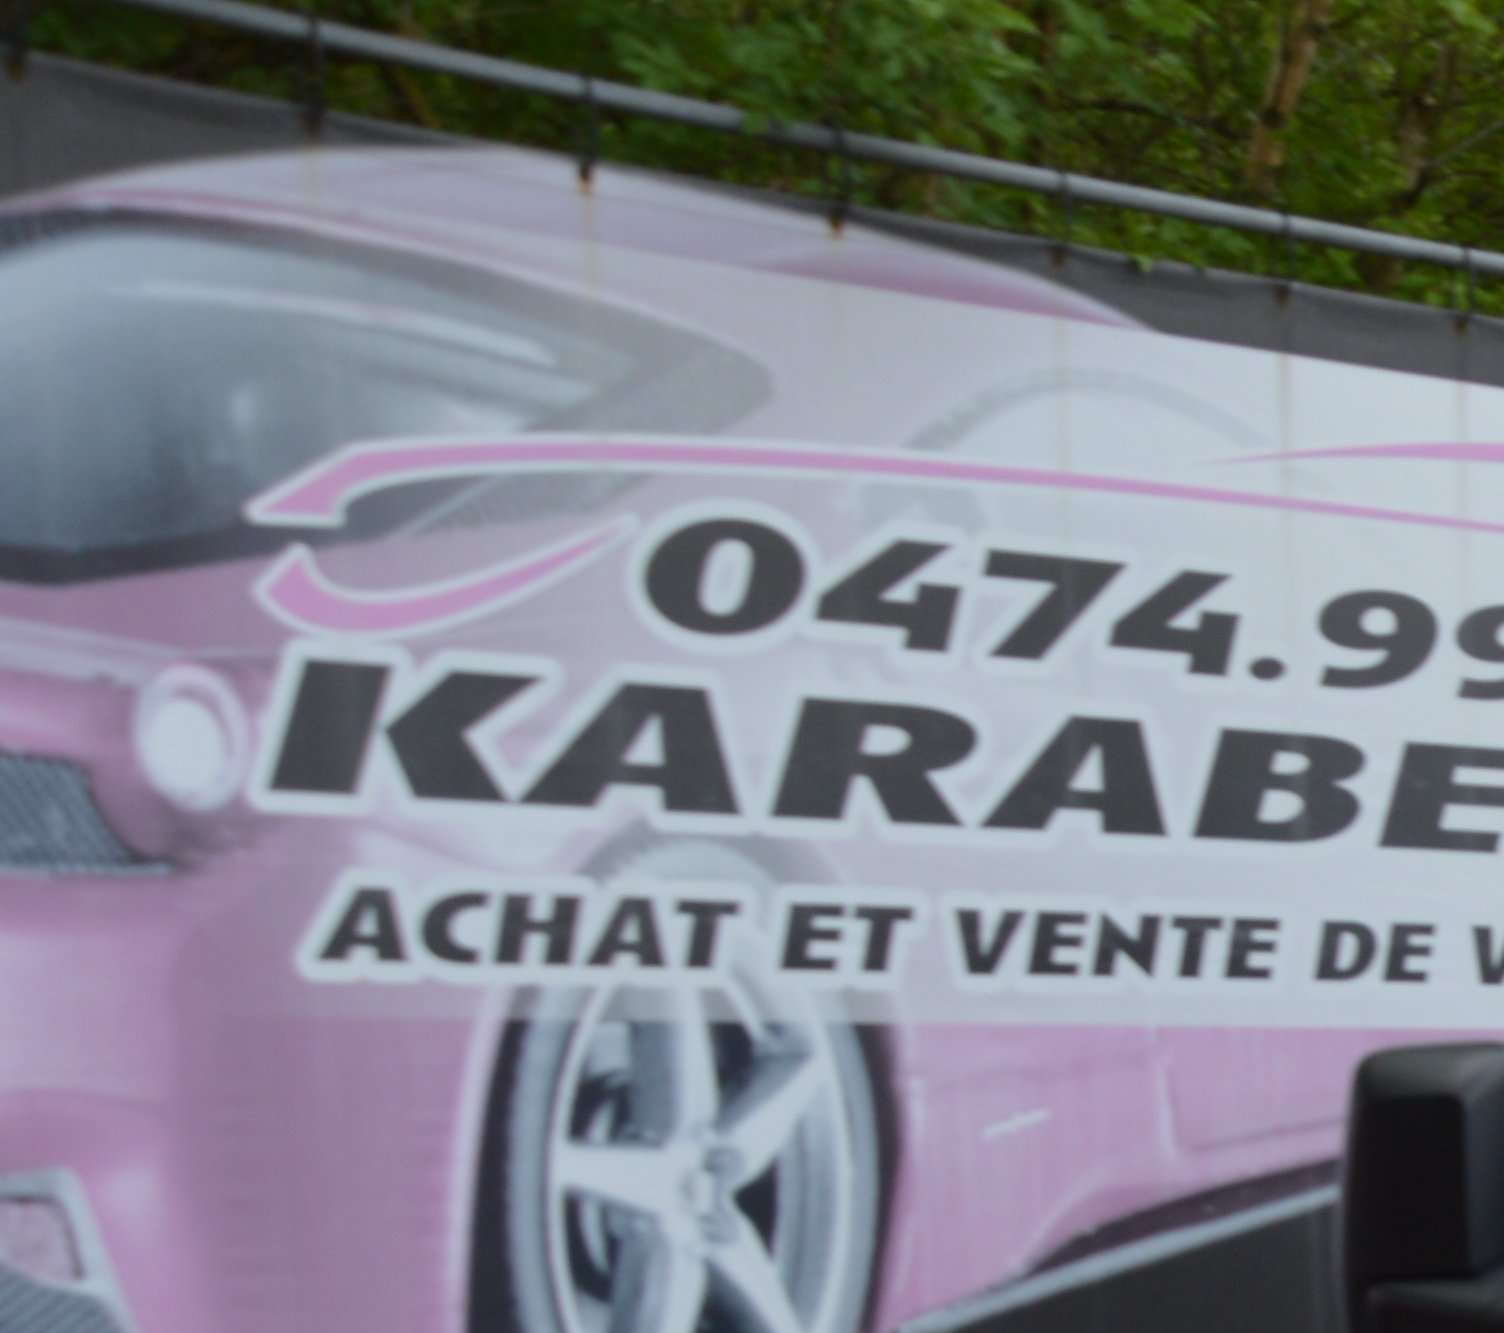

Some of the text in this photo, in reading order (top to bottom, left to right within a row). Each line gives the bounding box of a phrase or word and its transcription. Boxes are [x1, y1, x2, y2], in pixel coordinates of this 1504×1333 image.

[318, 887, 740, 969] ACHAT
[780, 903, 912, 972] ET
[955, 908, 1281, 980] VENTE
[1313, 919, 1437, 982] DE
